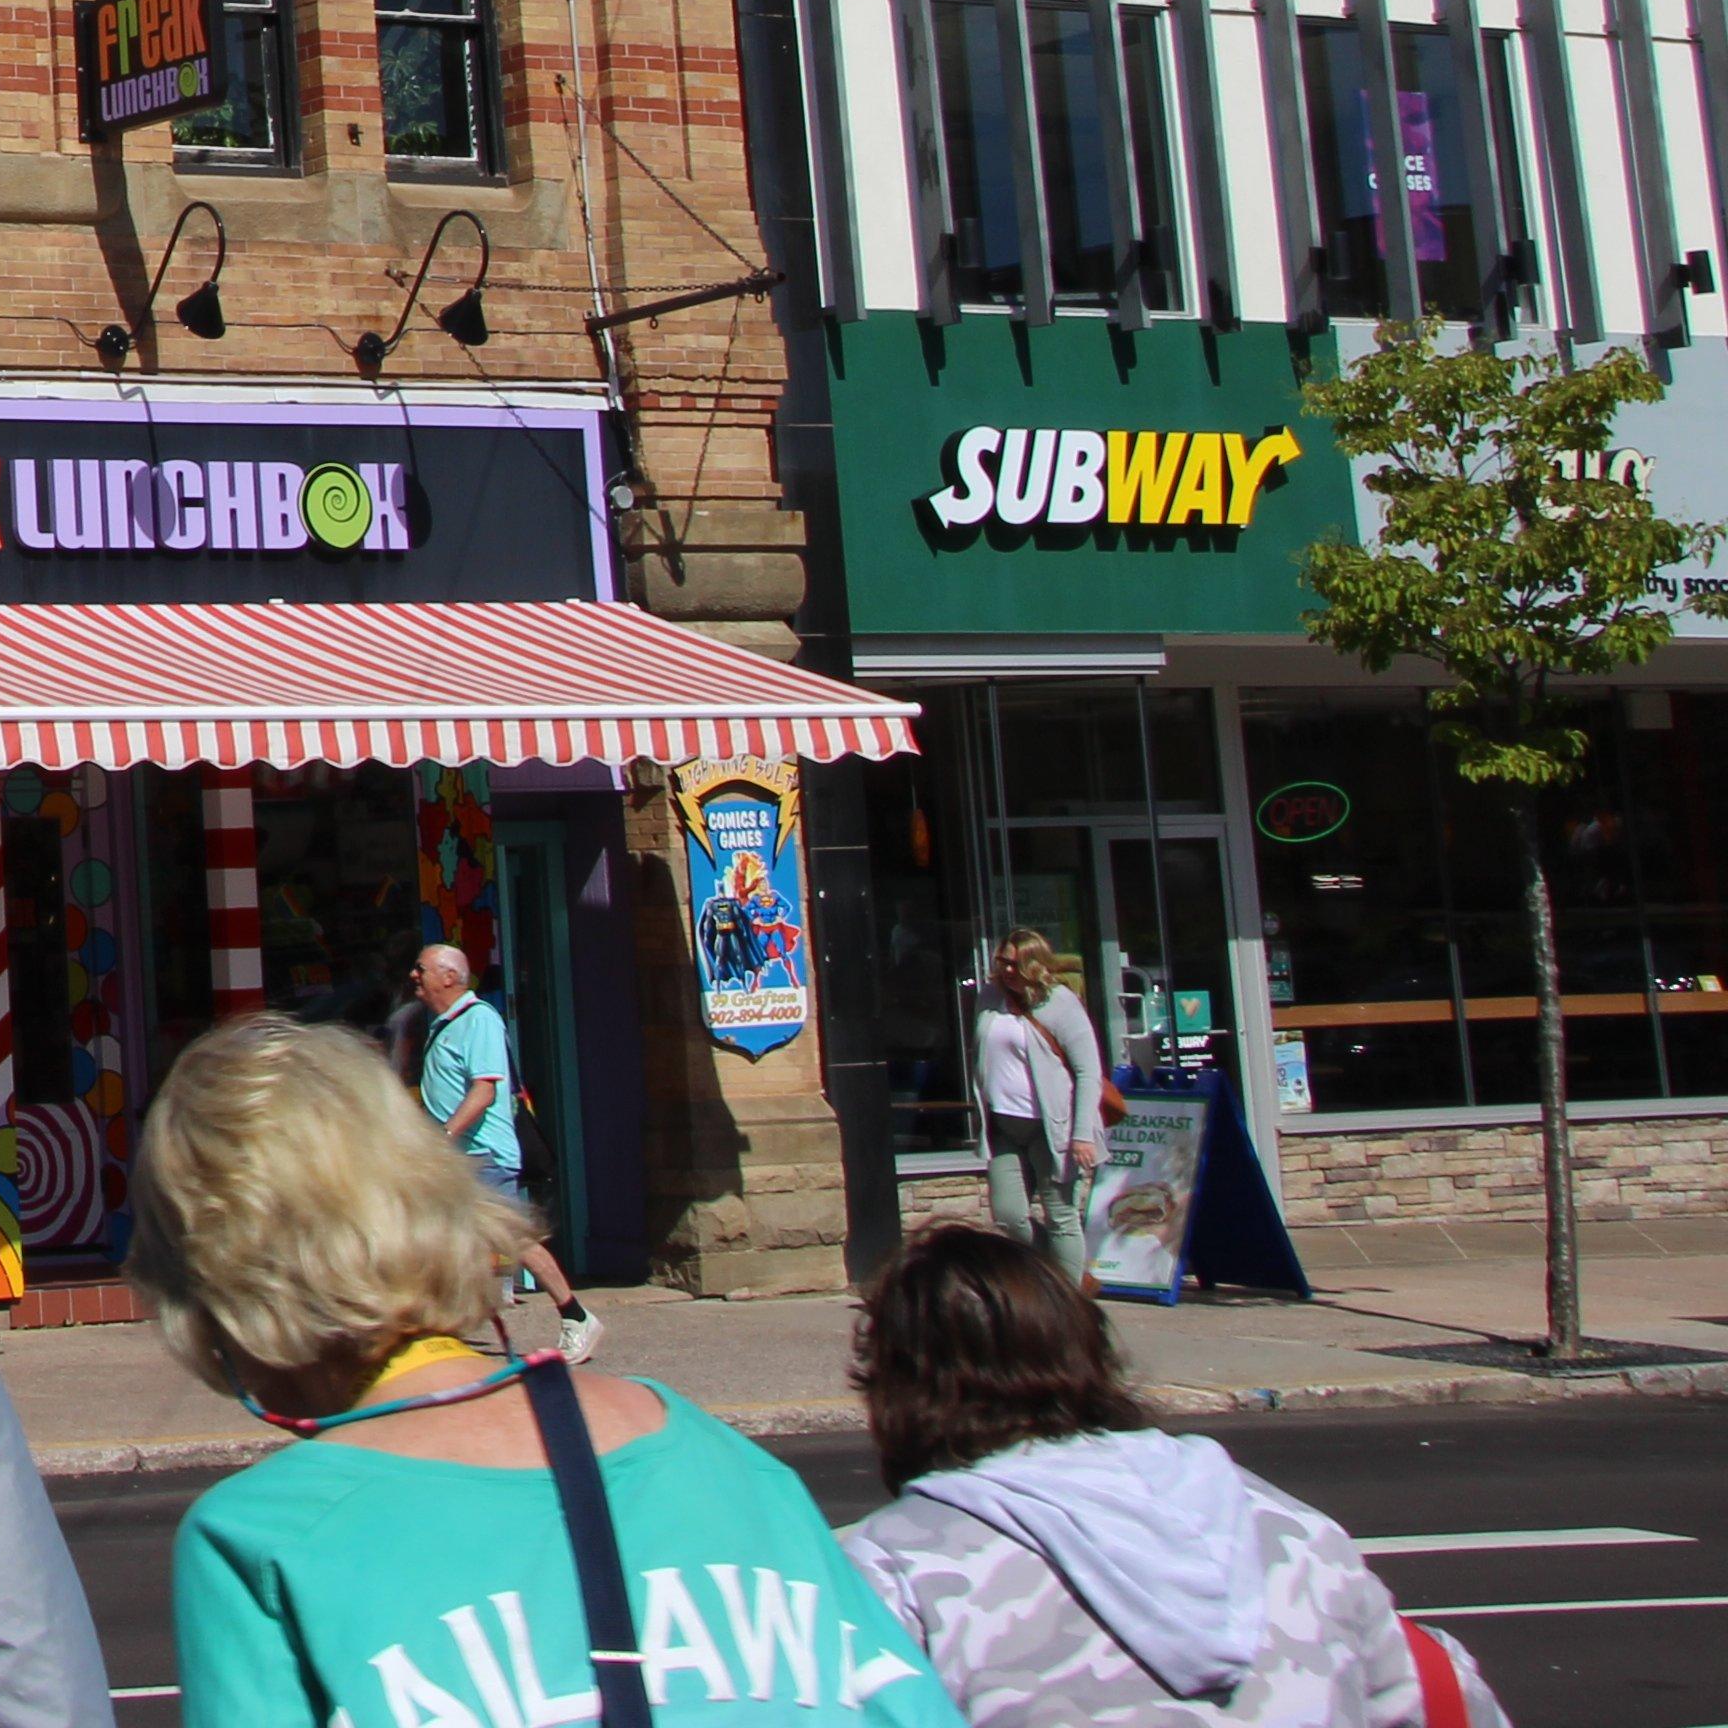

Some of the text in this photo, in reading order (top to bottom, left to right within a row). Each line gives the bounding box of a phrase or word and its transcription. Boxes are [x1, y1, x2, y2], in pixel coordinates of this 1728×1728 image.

[930, 424, 1304, 530] SUBWAY
[707, 810, 771, 831] COMICS &
[1268, 796, 1340, 827] OPEN
[718, 830, 764, 850] GAMES
[1161, 1034, 1210, 1050] SBWAY
[1122, 1114, 1194, 1131] REAKFAST
[1109, 1130, 1168, 1145] ALL DAY.
[339, 1590, 602, 1728] AIL
